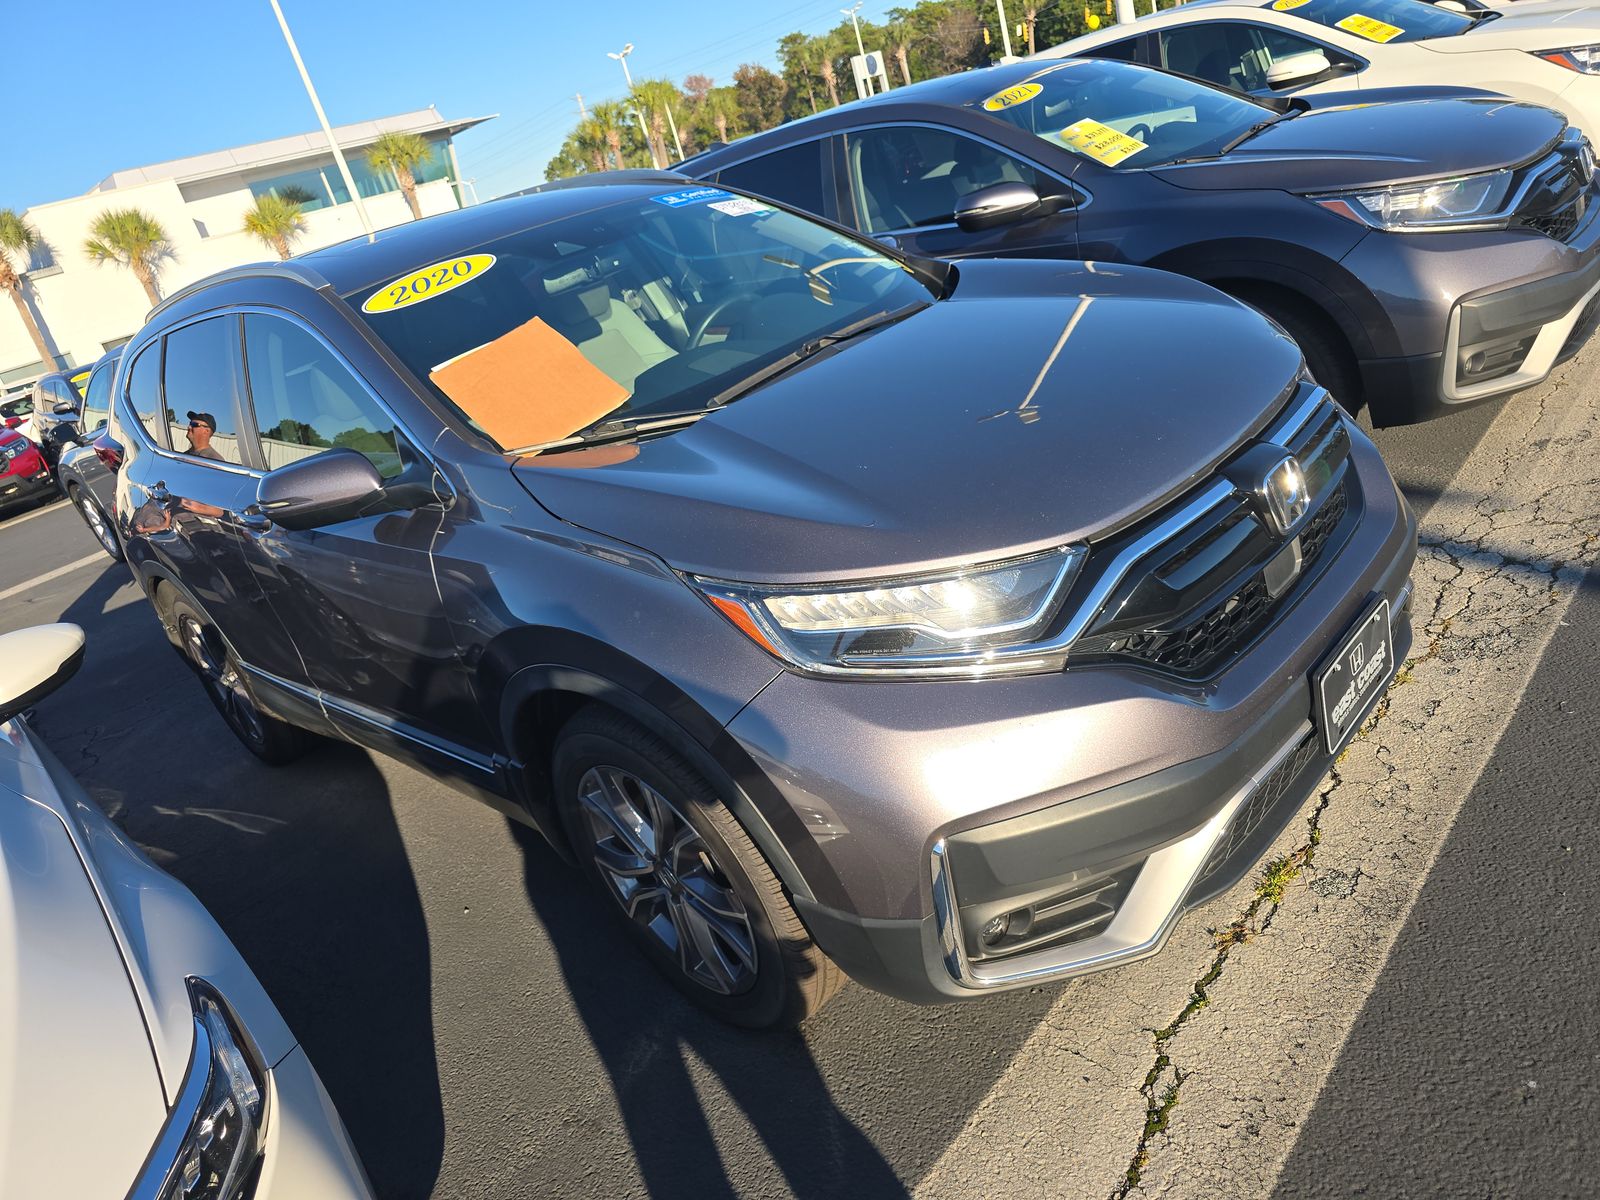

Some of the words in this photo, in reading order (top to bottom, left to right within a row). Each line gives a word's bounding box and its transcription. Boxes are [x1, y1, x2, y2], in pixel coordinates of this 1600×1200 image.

[995, 86, 1032, 107] 2021
[389, 260, 472, 306] 2020
[1331, 679, 1356, 724] east
[1356, 639, 1386, 689] coast
